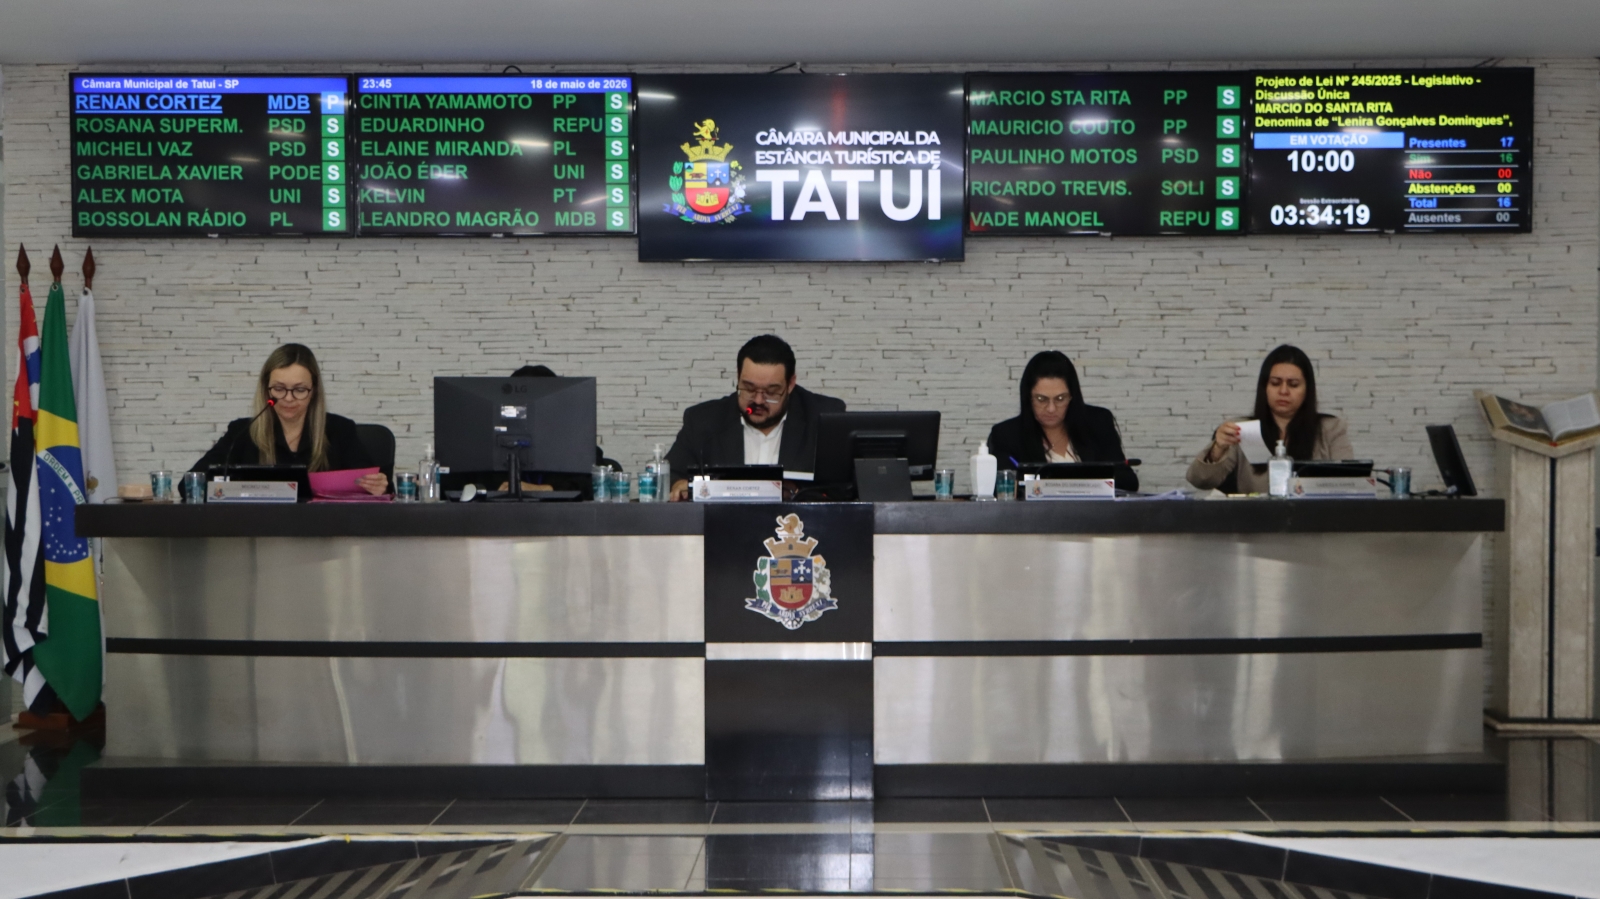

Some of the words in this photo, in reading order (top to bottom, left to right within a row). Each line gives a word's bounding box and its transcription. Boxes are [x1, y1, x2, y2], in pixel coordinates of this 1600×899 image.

[81, 79, 121, 89] Câmara
[124, 79, 173, 90] Municipal
[175, 80, 188, 89] de
[224, 80, 239, 89] SP
[362, 79, 392, 89] 23:45
[531, 80, 542, 89] 18
[545, 80, 558, 89] de
[560, 79, 586, 89] maio
[588, 80, 601, 89] de
[603, 80, 627, 89] 2026
[1255, 76, 1296, 89] Projeto
[1299, 76, 1313, 86] de
[1316, 76, 1333, 86] Lei
[1351, 75, 1402, 86] 245/2025
[1411, 75, 1474, 88] Legislativo
[360, 94, 422, 109] CINTIA
[425, 94, 533, 109] YAMAMOTO
[553, 94, 577, 109] PP
[610, 94, 623, 109] S
[970, 90, 1045, 105] MARCIO
[1051, 90, 1086, 105] STA
[1090, 90, 1131, 105] RITA
[1164, 90, 1187, 105] PP
[1222, 90, 1235, 105] S
[1255, 89, 1315, 100] Discussão
[1318, 88, 1350, 100] Única
[75, 95, 140, 110] RENAN
[145, 95, 222, 110] CORTEZ
[268, 95, 310, 110] MDB
[327, 95, 339, 109] P
[1255, 103, 1302, 113] MARCIO
[1305, 103, 1323, 113] DO
[1325, 102, 1365, 113] SANTA
[1366, 102, 1393, 113] RITA
[75, 118, 155, 133] ROSANA
[159, 118, 243, 133] SUPERM.
[268, 119, 306, 133] PSD
[327, 119, 339, 133] S
[360, 118, 485, 133] EDUARDINHO
[553, 118, 602, 133] REPU
[610, 118, 623, 133] S
[970, 120, 1064, 135] MAURICIO
[1069, 120, 1135, 135] COUTO
[1163, 120, 1187, 135] PP
[1222, 119, 1235, 134] S
[1255, 117, 1312, 127] Denomina
[1315, 117, 1329, 127] de
[1376, 116, 1436, 128] Gonçalves
[755, 128, 826, 146] CÂMARA
[827, 131, 915, 146] MUNICIPAL
[915, 131, 941, 146] DA
[1290, 135, 1307, 145] EM
[1311, 133, 1368, 147] VOTAÇÃO
[1409, 137, 1467, 148] Presentes
[1500, 137, 1514, 147] 17
[76, 142, 152, 157] MICHELI
[158, 142, 193, 157] VAZ
[268, 142, 306, 157] PSD
[327, 142, 339, 156] S
[361, 141, 429, 157] ELAINE
[435, 141, 523, 157] MIRANDA
[553, 141, 576, 156] PL
[610, 141, 623, 156] S
[755, 148, 834, 165] ESTÂNCIA
[835, 148, 915, 165] TURÍSTICA
[916, 150, 941, 165] DE
[970, 149, 1065, 164] PAULINHO
[1070, 149, 1137, 164] MOTOS
[1162, 149, 1199, 164] PSD
[1222, 149, 1234, 164] S
[1287, 150, 1355, 172] 10:00
[1409, 154, 1431, 163] Sim
[1500, 153, 1513, 163] 16
[77, 165, 173, 180] GABRIELA
[177, 165, 243, 180] XAVIER
[269, 165, 321, 180] PODE
[327, 165, 340, 180] S
[360, 161, 412, 180] JOÃO
[417, 161, 468, 180] ÉDER
[554, 165, 585, 180] UNI
[611, 165, 623, 180] S
[1409, 169, 1432, 179] Não
[1498, 168, 1512, 178] 00
[77, 188, 126, 203] ALEX
[131, 188, 184, 203] MOTA
[270, 189, 301, 203] UNI
[328, 189, 340, 203] S
[360, 188, 425, 203] KELVIN
[553, 188, 576, 203] PT
[611, 188, 624, 203] S
[755, 164, 941, 221] TATUÍ
[970, 181, 1056, 196] RICARDO
[1062, 180, 1132, 196] TREVIS.
[1161, 180, 1204, 195] SOLI
[1221, 180, 1234, 195] S
[1408, 183, 1476, 195] Abstenções
[1497, 183, 1512, 193] 00
[1408, 197, 1437, 208] Total
[1497, 197, 1511, 207] 16
[78, 212, 181, 227] BOSSOLAN
[187, 208, 247, 227] RÁDIO
[270, 212, 293, 227] PL
[328, 212, 340, 227] S
[360, 211, 450, 227] LEANDRO
[456, 208, 539, 227] MAGRÃO
[555, 211, 596, 226] MDB
[611, 211, 624, 226] S
[970, 212, 1019, 227] VADE
[1025, 211, 1104, 226] MANOEL
[1160, 211, 1210, 226] REPU
[1221, 210, 1234, 226] S
[1270, 205, 1370, 225] 03:34:19
[1408, 213, 1461, 222] Ausentes
[1496, 212, 1510, 222] 00
[43, 452, 68, 481] ORDEM
